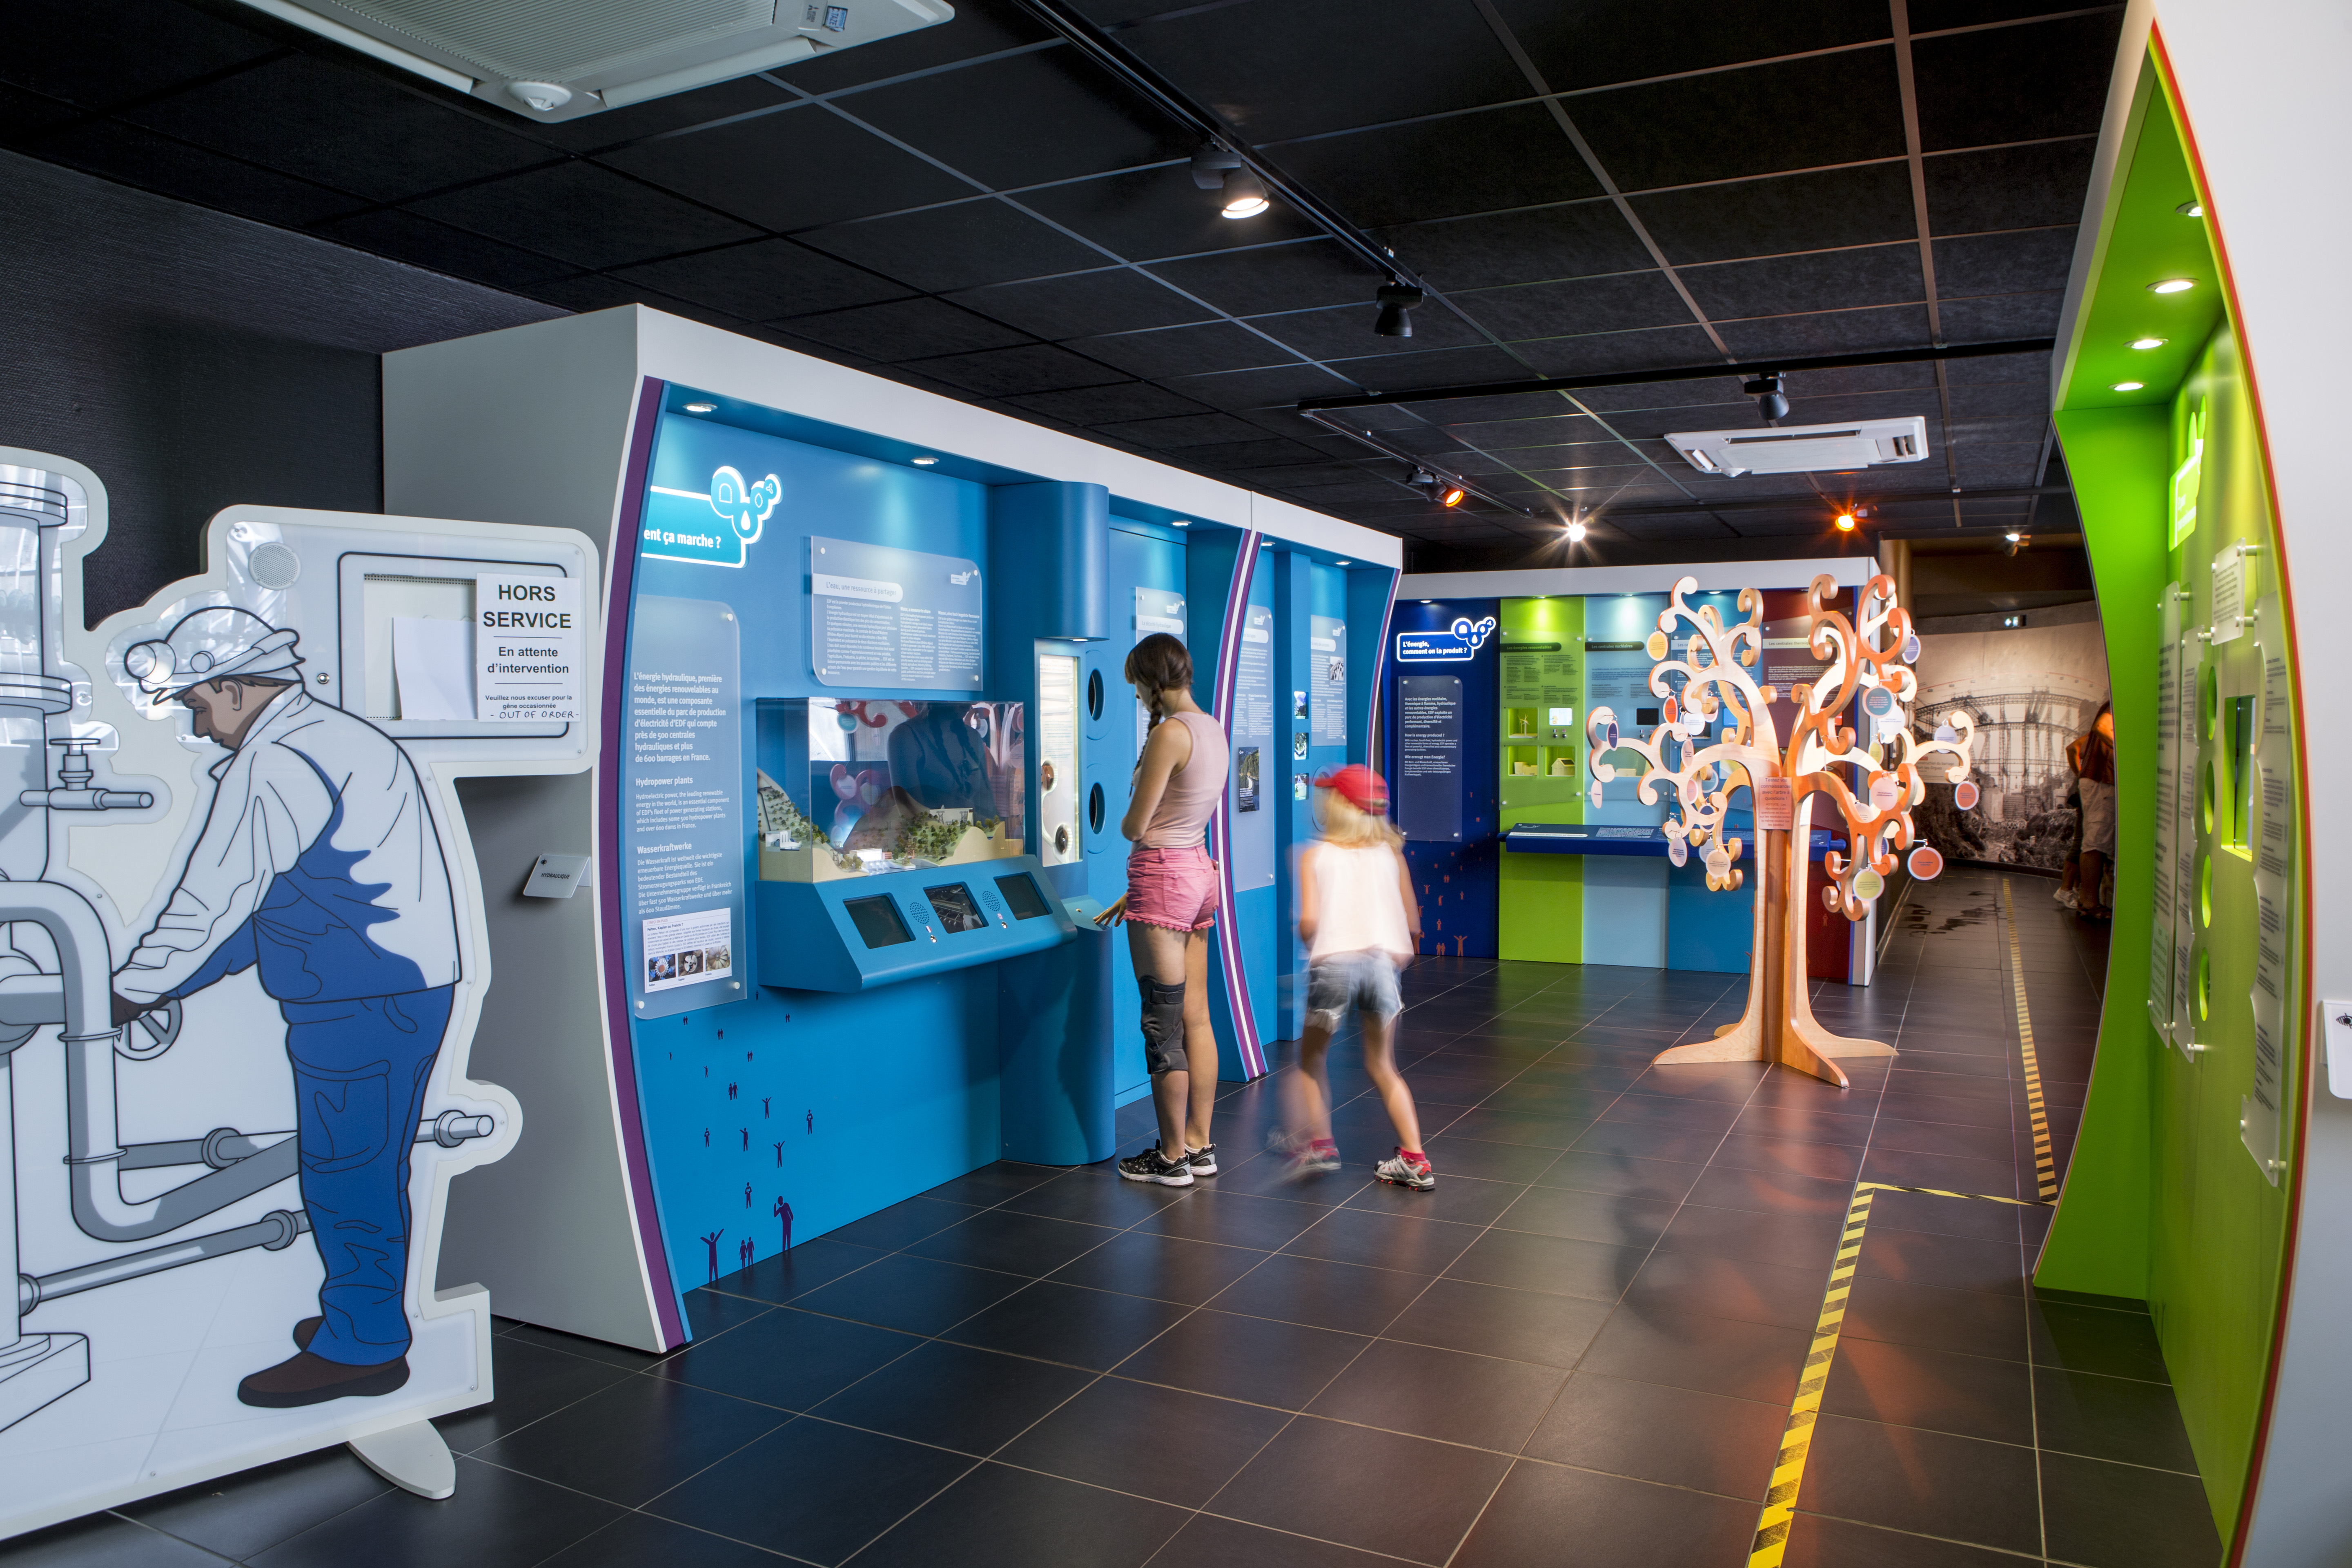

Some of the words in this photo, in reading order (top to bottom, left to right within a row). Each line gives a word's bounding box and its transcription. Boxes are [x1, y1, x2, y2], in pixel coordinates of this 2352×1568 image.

[663, 532, 675, 545] ça
[677, 534, 713, 548] marche
[715, 537, 721, 548] ?
[826, 581, 840, 590] L'eau,
[499, 585, 555, 601] HORS
[483, 612, 571, 628] SERVICE
[499, 647, 514, 656] En
[519, 648, 558, 657] attente
[488, 664, 569, 673] d'intervention
[634, 673, 661, 682] L'énergie
[662, 673, 697, 683] hydraulique,
[697, 675, 722, 683] première
[646, 684, 671, 694] énergies
[634, 696, 656, 705] monde,
[697, 708, 726, 717] production
[686, 719, 696, 728] qui
[696, 720, 717, 728] compte
[635, 731, 648, 740] près
[635, 742, 673, 752] hydrauliques
[681, 742, 693, 751] plus
[657, 754, 682, 763] barrages
[636, 778, 673, 787] Hydropower
[674, 776, 693, 786] plants
[637, 842, 692, 853] Wasserkraftwerke
